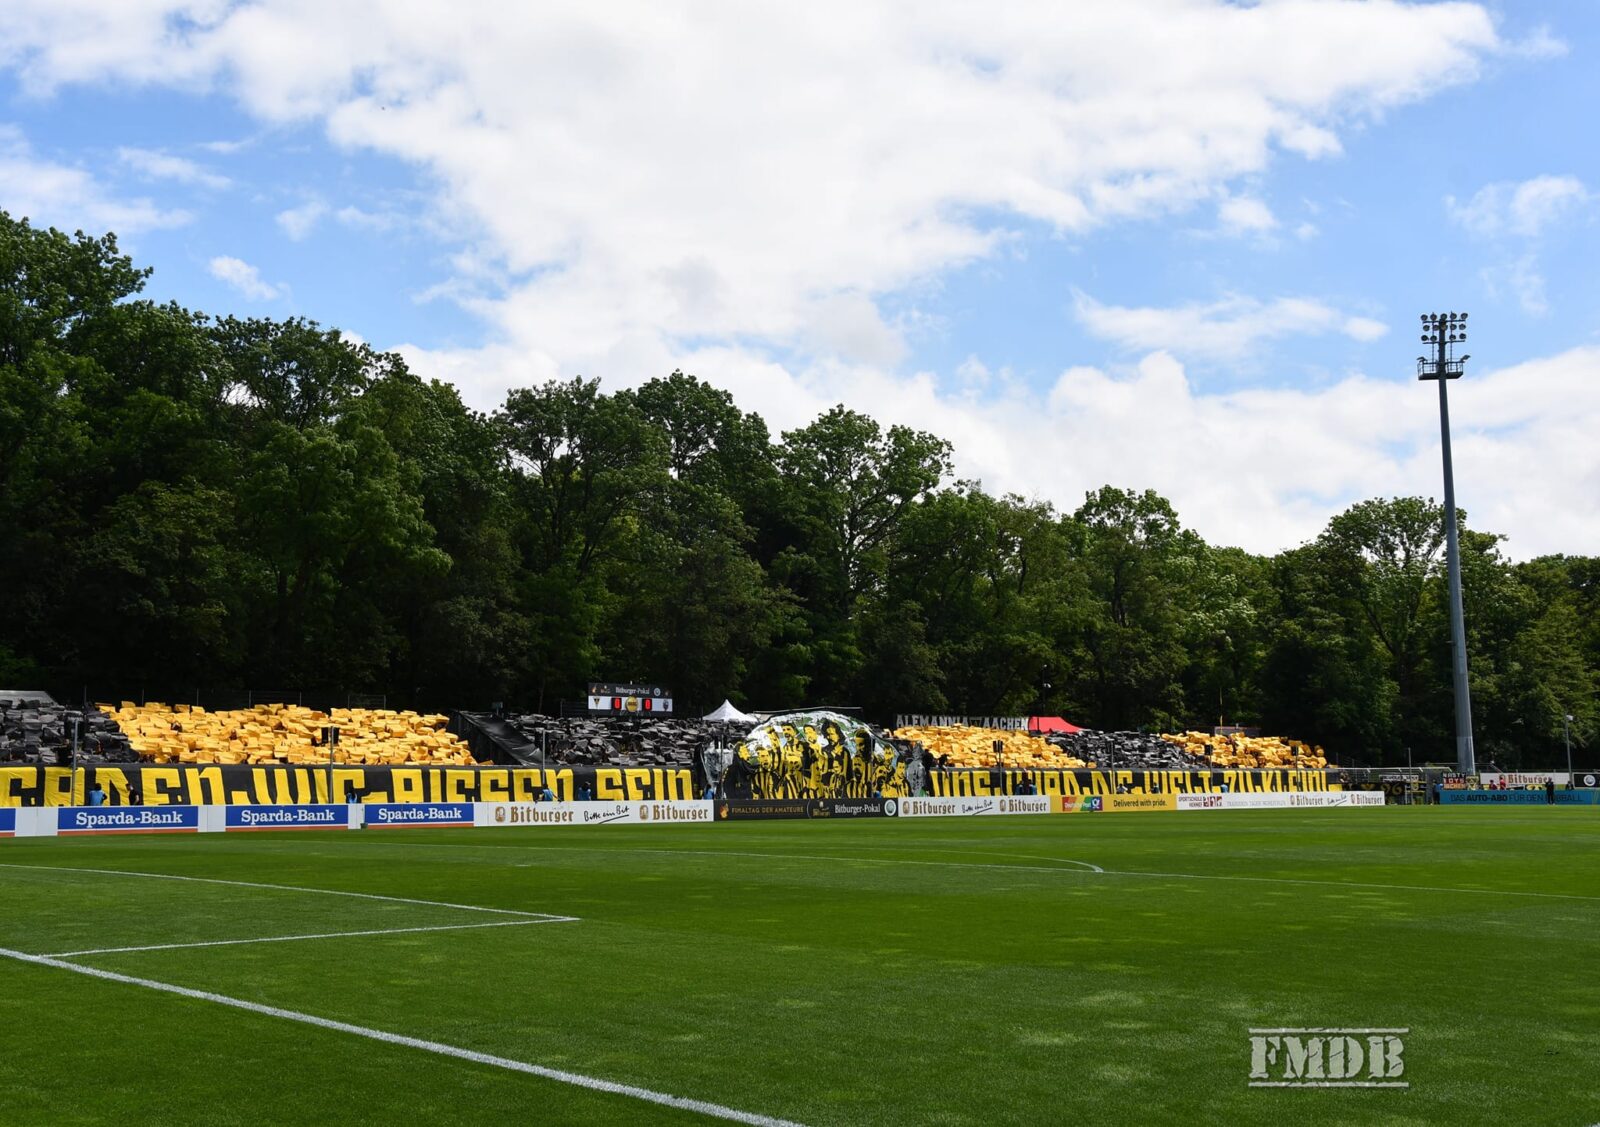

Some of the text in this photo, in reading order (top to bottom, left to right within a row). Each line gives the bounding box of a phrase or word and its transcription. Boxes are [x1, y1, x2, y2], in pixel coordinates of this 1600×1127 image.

[896, 714, 1028, 731] ALEMANNIA AACHEN
[834, 804, 881, 815] Bitburger-Pokal
[912, 801, 956, 815] Bitburger
[1008, 800, 1047, 813] Bitburger
[1140, 799, 1151, 807] with
[1152, 799, 1168, 808] pride.
[76, 811, 183, 828] Sparda-Bank
[241, 809, 335, 825] Sparda-Bank
[378, 807, 462, 823] Sparda-Bank
[510, 806, 574, 823] Bitburger
[652, 804, 709, 820] Bitburger
